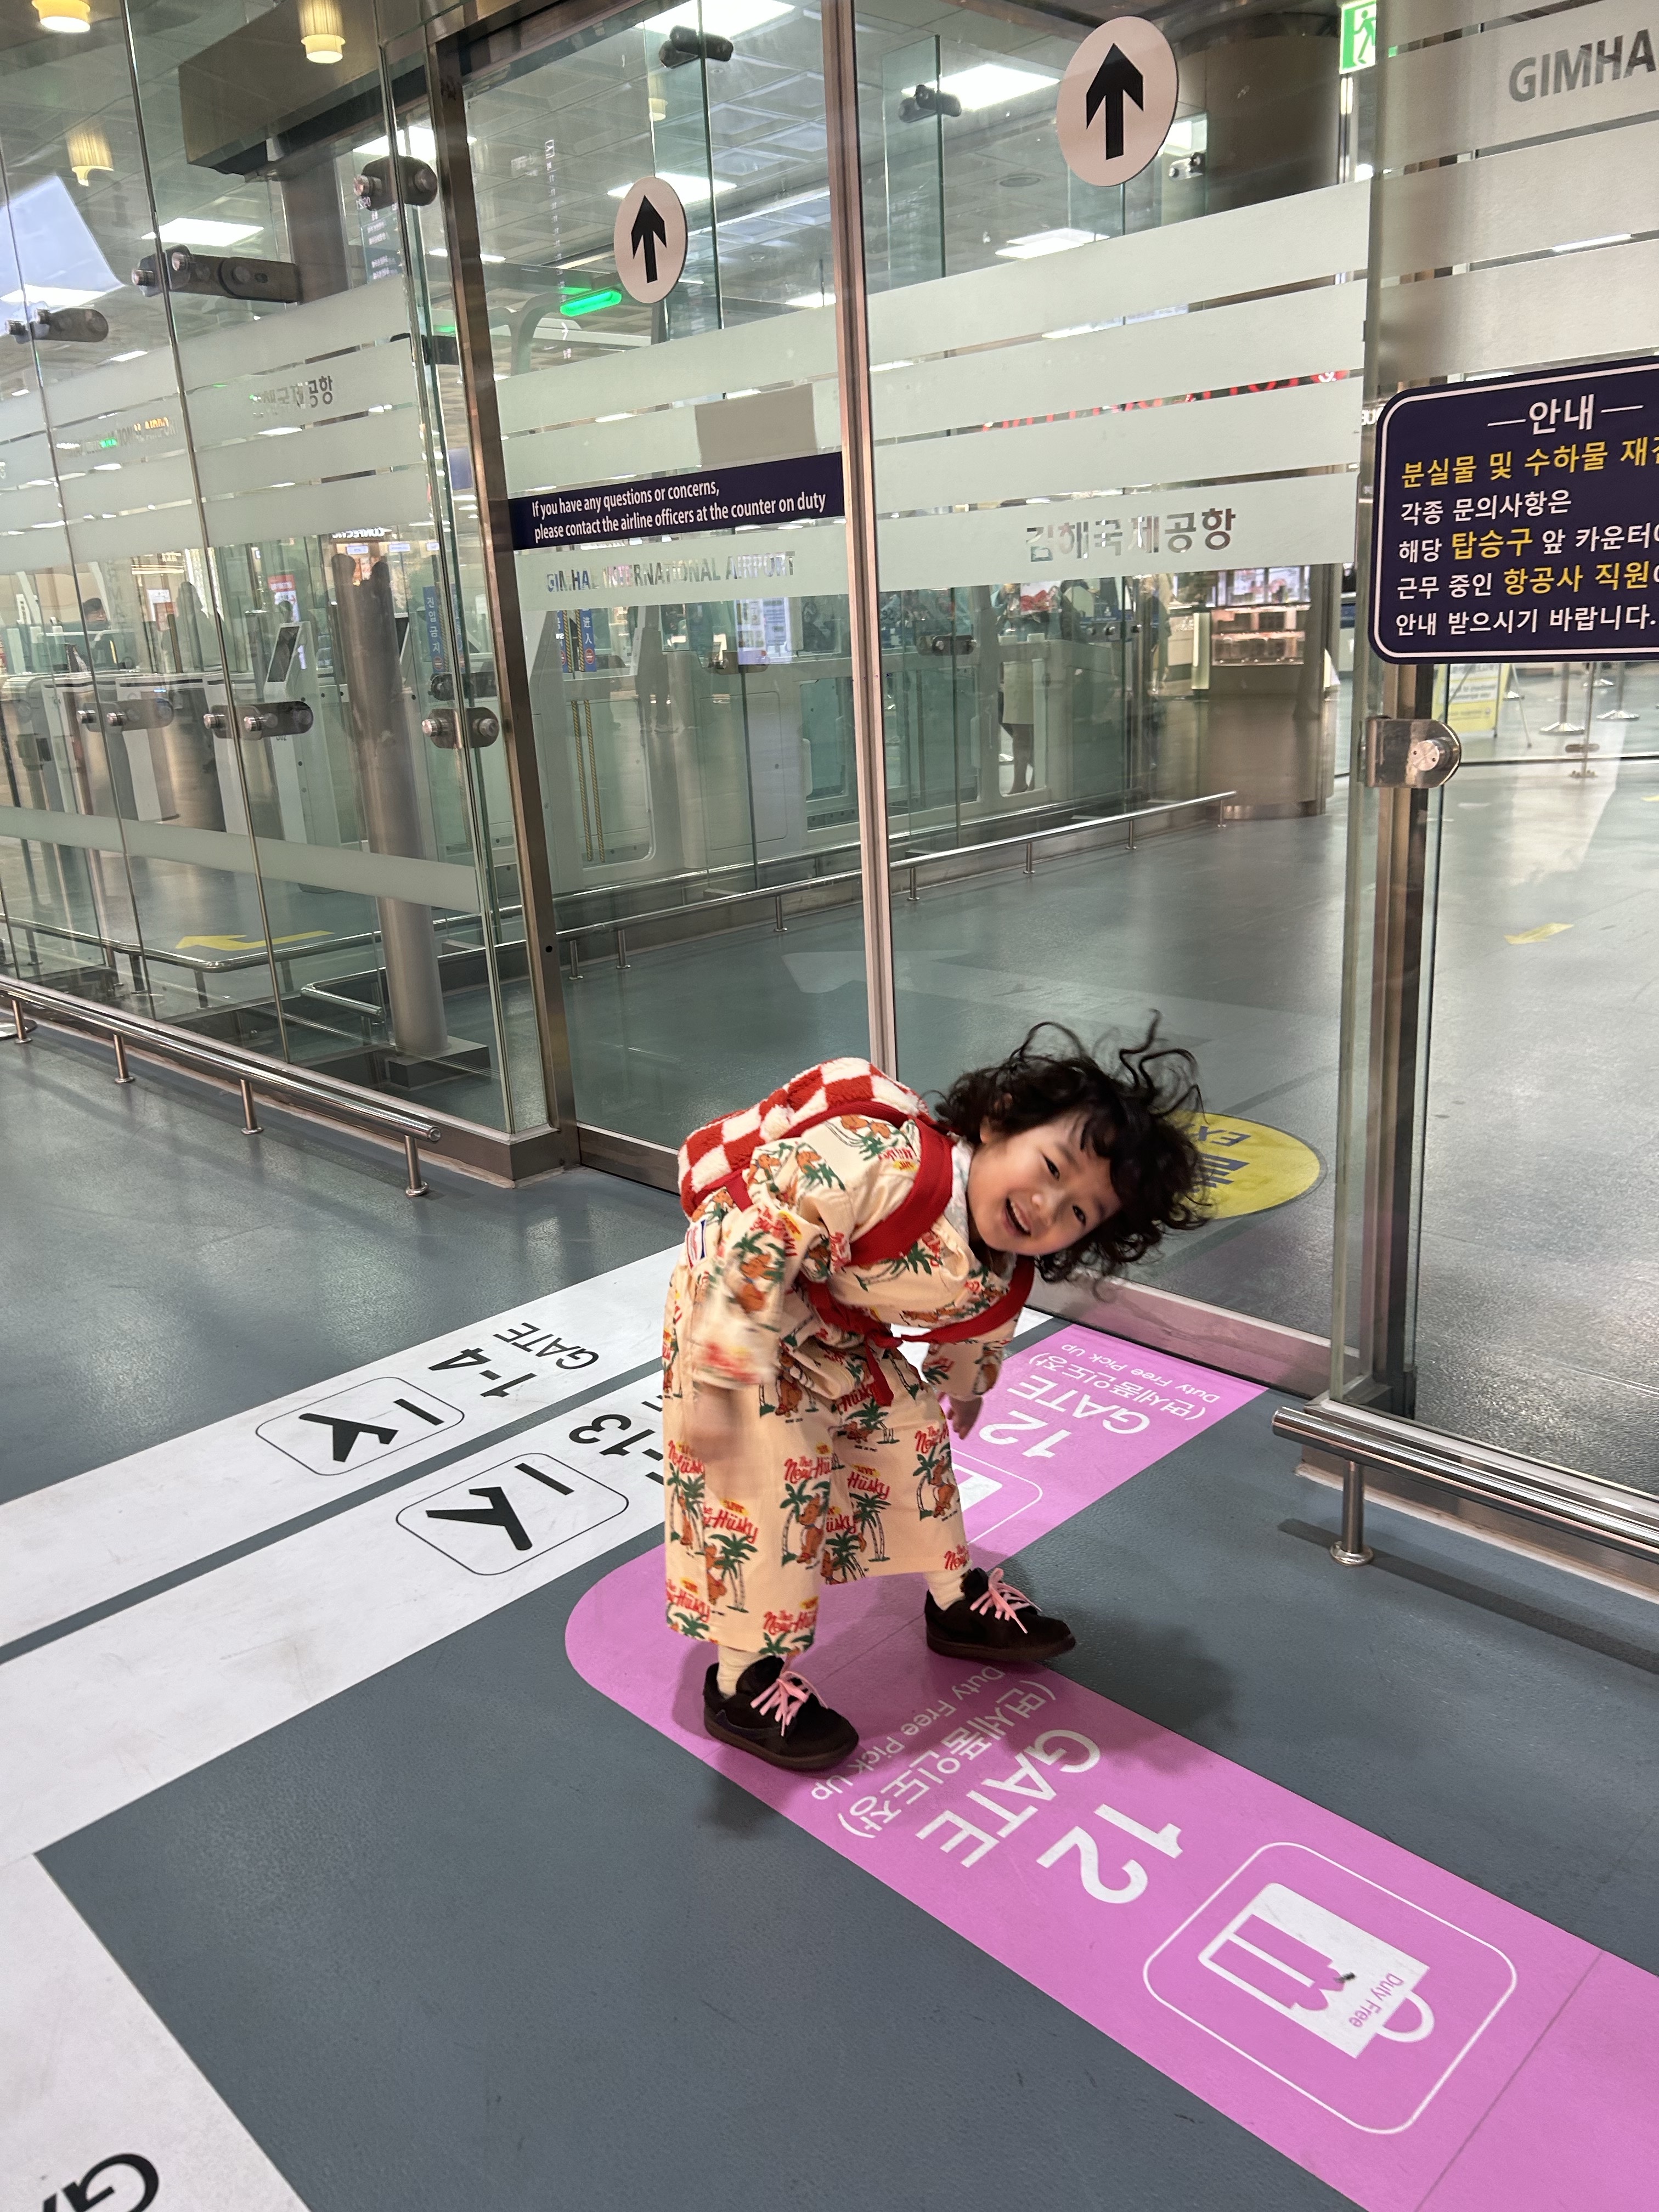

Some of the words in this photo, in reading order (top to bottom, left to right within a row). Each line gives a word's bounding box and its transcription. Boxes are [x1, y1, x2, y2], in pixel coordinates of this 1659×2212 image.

[1509, 29, 1657, 103] GIMHA
[1528, 394, 1595, 435] 안내
[1402, 455, 1477, 489] 분실물
[1489, 451, 1512, 481] 및
[1525, 441, 1609, 476] 수하물
[532, 500, 539, 517] If
[540, 504, 558, 520] you
[559, 498, 582, 514] have
[584, 496, 601, 513] any
[603, 488, 652, 511] questions
[654, 488, 665, 501] or
[668, 481, 720, 500] concerns,
[534, 523, 564, 544] please
[565, 518, 601, 537] contact
[602, 515, 619, 532] the
[620, 512, 653, 531] airline
[654, 507, 695, 527] officers
[696, 505, 708, 522] at
[709, 502, 729, 521] the
[731, 498, 776, 518] counter
[778, 497, 794, 513] on
[797, 491, 826, 514] duty
[1401, 500, 1443, 526] 각종
[1452, 489, 1572, 522] 문의사항은
[1399, 539, 1442, 563] 해당
[1452, 528, 1533, 560] 탑승구
[1542, 529, 1566, 554] 앞
[1397, 576, 1440, 600] 근무
[1448, 573, 1492, 599] 중인
[1504, 565, 1583, 595] 항공사
[1396, 612, 1437, 636] 안내
[1448, 608, 1538, 635] 받으시기
[1549, 605, 1657, 632] 바랍니다.
[493, 1322, 600, 1371] GATE
[1061, 1344, 1086, 1357] Up
[1090, 1353, 1128, 1371] Pick
[427, 1348, 538, 1398] 1-4
[1029, 1352, 1206, 1420] (면세품인도장)
[1130, 1368, 1173, 1387] Free
[1007, 1374, 1150, 1434] GATE
[1175, 1383, 1220, 1403] Duty
[568, 1413, 665, 1487] -13
[979, 1410, 1073, 1458] 12
[951, 1665, 1006, 1701] Duty
[900, 1700, 957, 1736] Free
[837, 1680, 1056, 1838] (면세품인도장)
[847, 1736, 905, 1774] Pick
[811, 1774, 854, 1800] Up
[915, 1729, 1101, 1869] GATE
[1036, 1803, 1184, 1904] 12
[1370, 1972, 1404, 2001] Duty
[1349, 1999, 1382, 2027] Free
[43, 2153, 159, 2212] G
